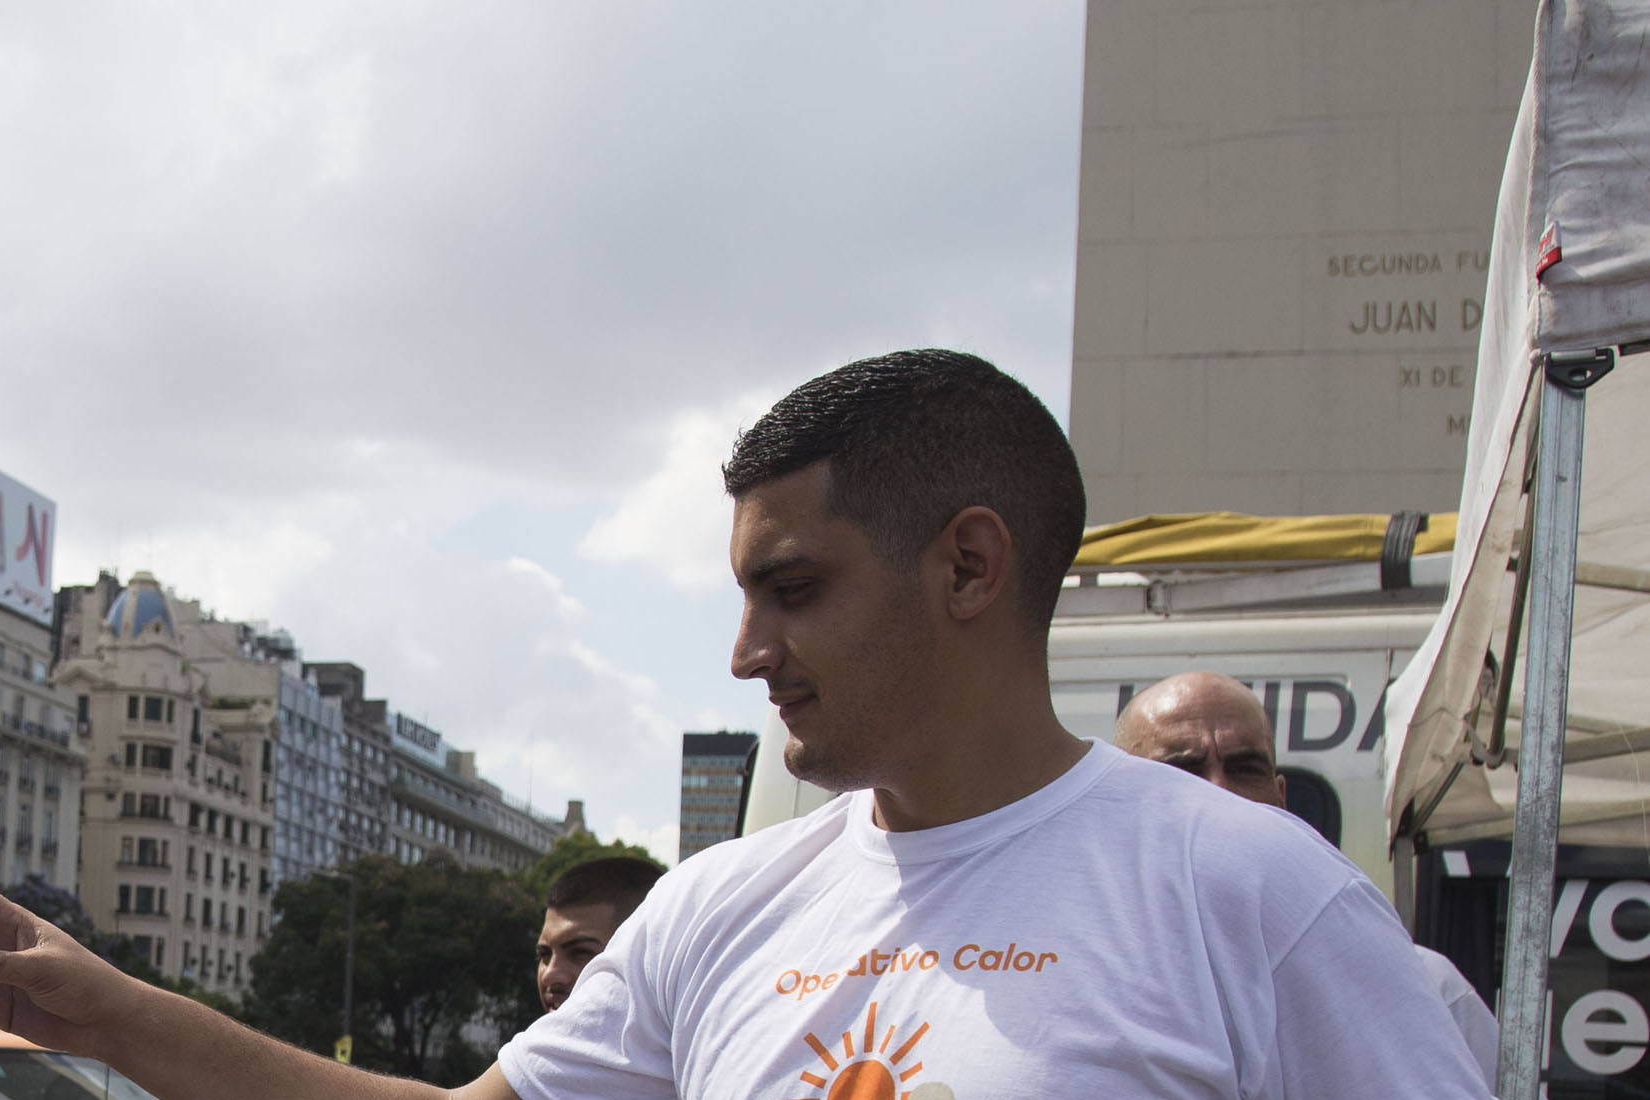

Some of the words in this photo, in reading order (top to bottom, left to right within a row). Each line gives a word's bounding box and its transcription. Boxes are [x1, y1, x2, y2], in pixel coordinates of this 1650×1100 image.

[1327, 252, 1443, 278] SEGUNDA
[1348, 300, 1437, 335] JUAN
[1401, 366, 1422, 388] XI
[1431, 365, 1464, 389] DE
[775, 947, 939, 1000] Opeativo
[953, 943, 1058, 972] Calor
